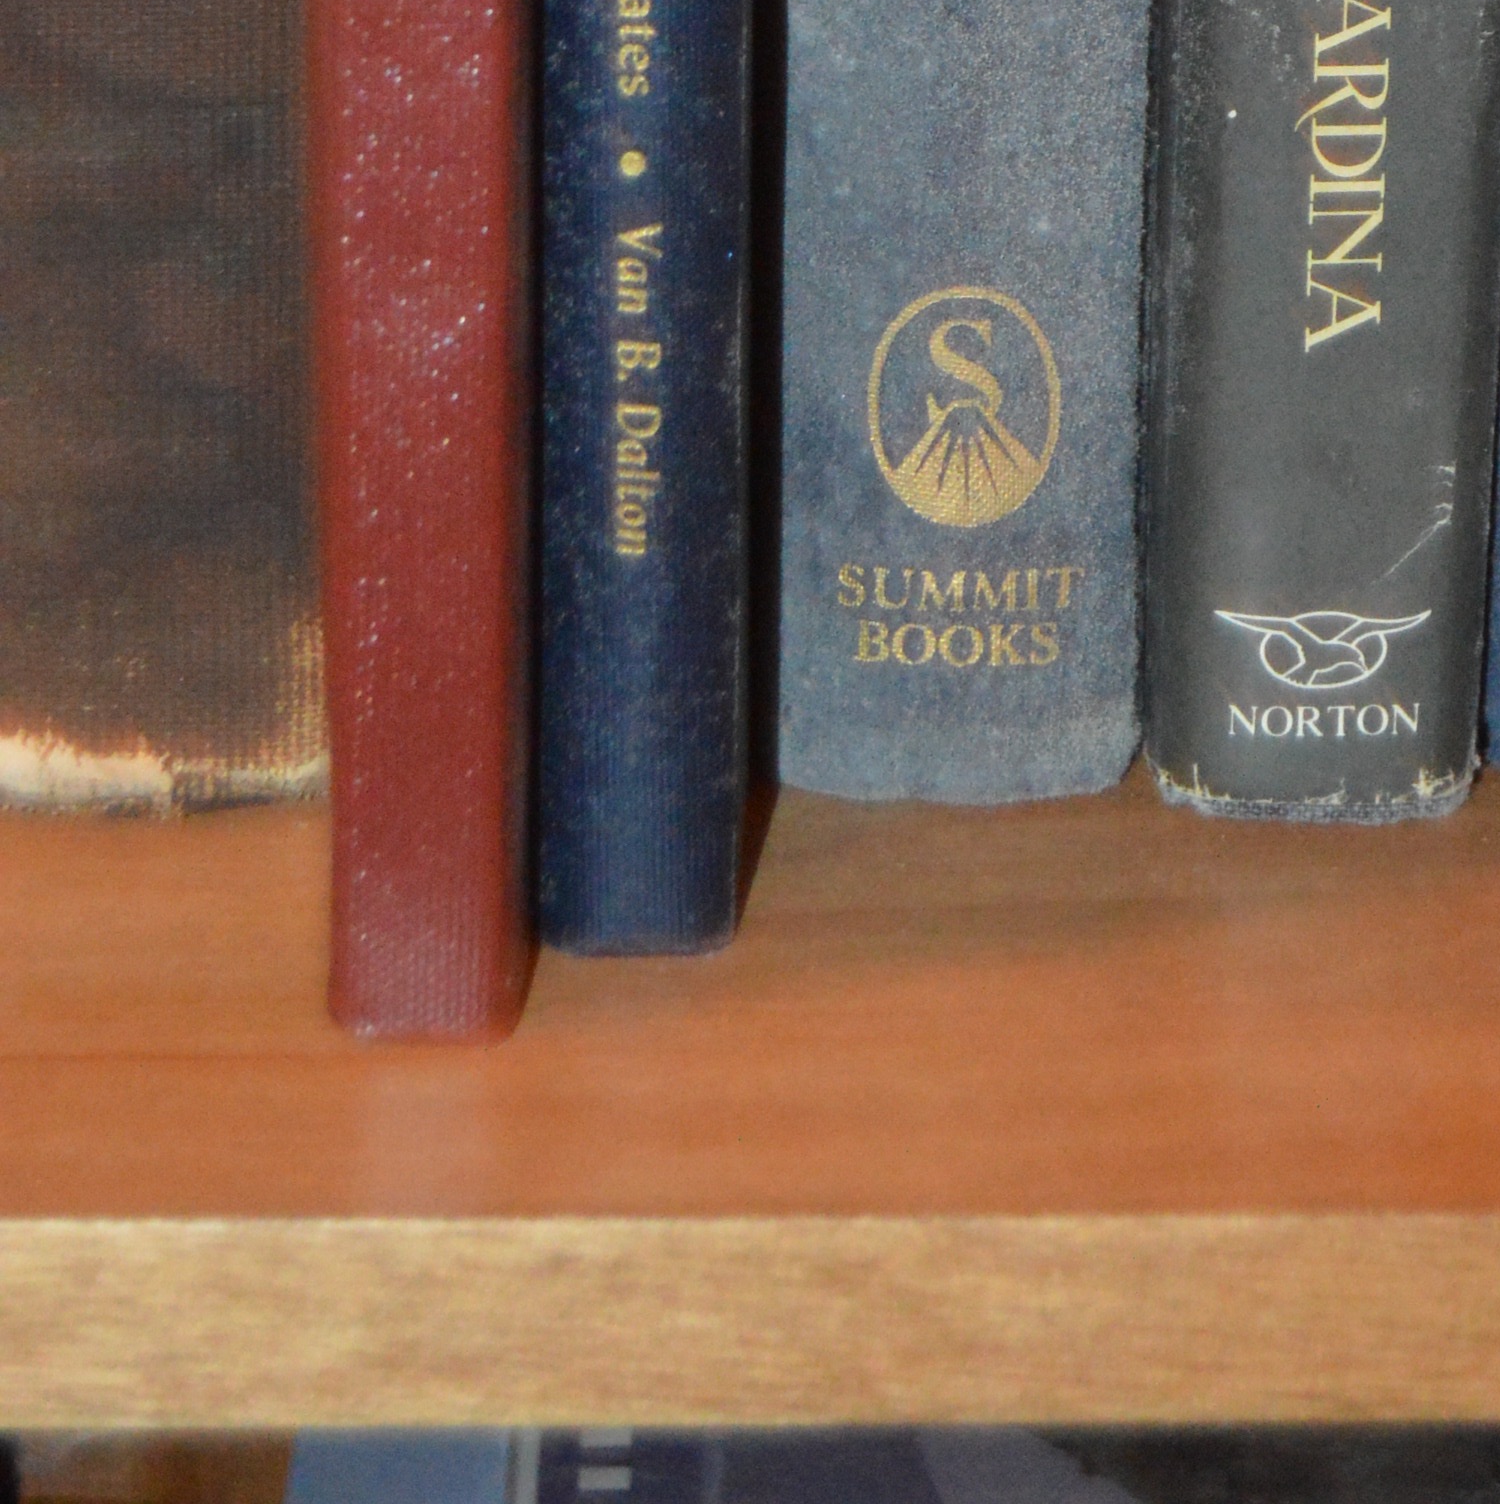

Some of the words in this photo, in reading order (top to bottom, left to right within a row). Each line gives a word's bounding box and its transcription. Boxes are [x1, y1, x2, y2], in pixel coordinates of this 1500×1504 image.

[617, 221, 664, 313] Van
[618, 339, 662, 384] B.
[613, 399, 662, 559] Dalton
[836, 563, 1086, 613] SUMMIT
[853, 620, 1061, 667] BOOKS
[1227, 702, 1421, 739] NORTON
